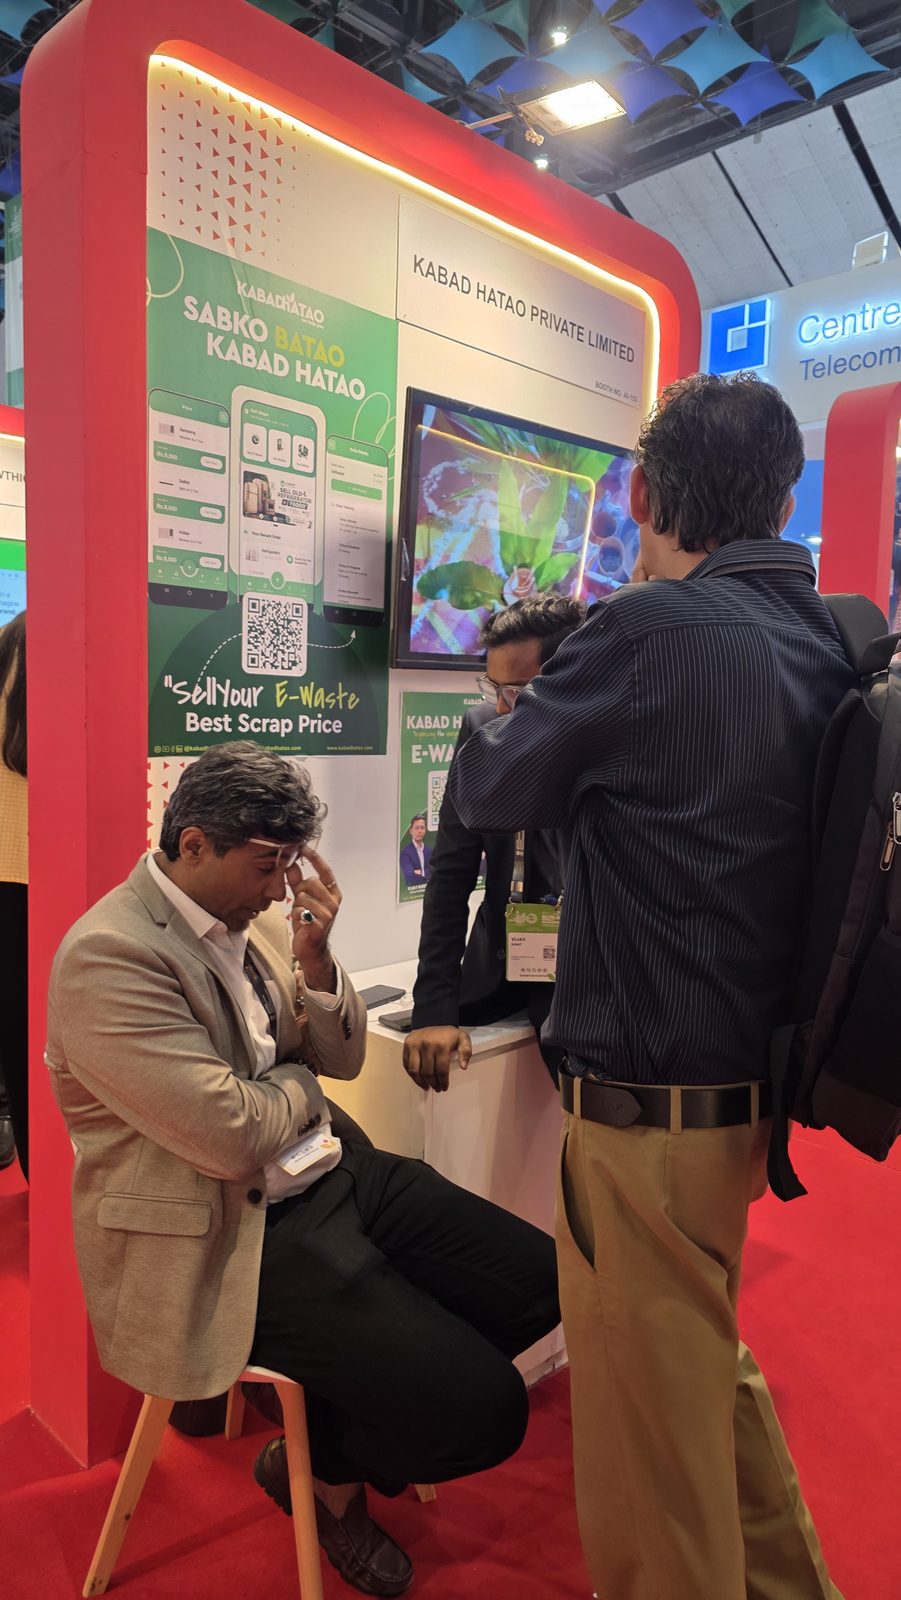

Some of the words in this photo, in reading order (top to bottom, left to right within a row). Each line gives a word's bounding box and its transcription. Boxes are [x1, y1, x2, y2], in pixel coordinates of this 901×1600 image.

[413, 254, 471, 295] KABAD
[476, 282, 526, 318] HATAO
[530, 305, 584, 342] PRIVATE
[588, 330, 635, 363] LIMITED
[799, 302, 901, 345] Centre
[184, 295, 268, 342] SABKO
[274, 325, 345, 368] BATAO
[207, 331, 289, 377] KABAD
[295, 360, 366, 401] HATAO
[800, 345, 901, 381] Telecom
[275, 680, 360, 710] E-Waste
[186, 712, 232, 733] Best
[238, 714, 293, 737] Scrap
[298, 714, 343, 734] Price
[406, 715, 450, 729] KABAD
[411, 743, 455, 763] E-WA
